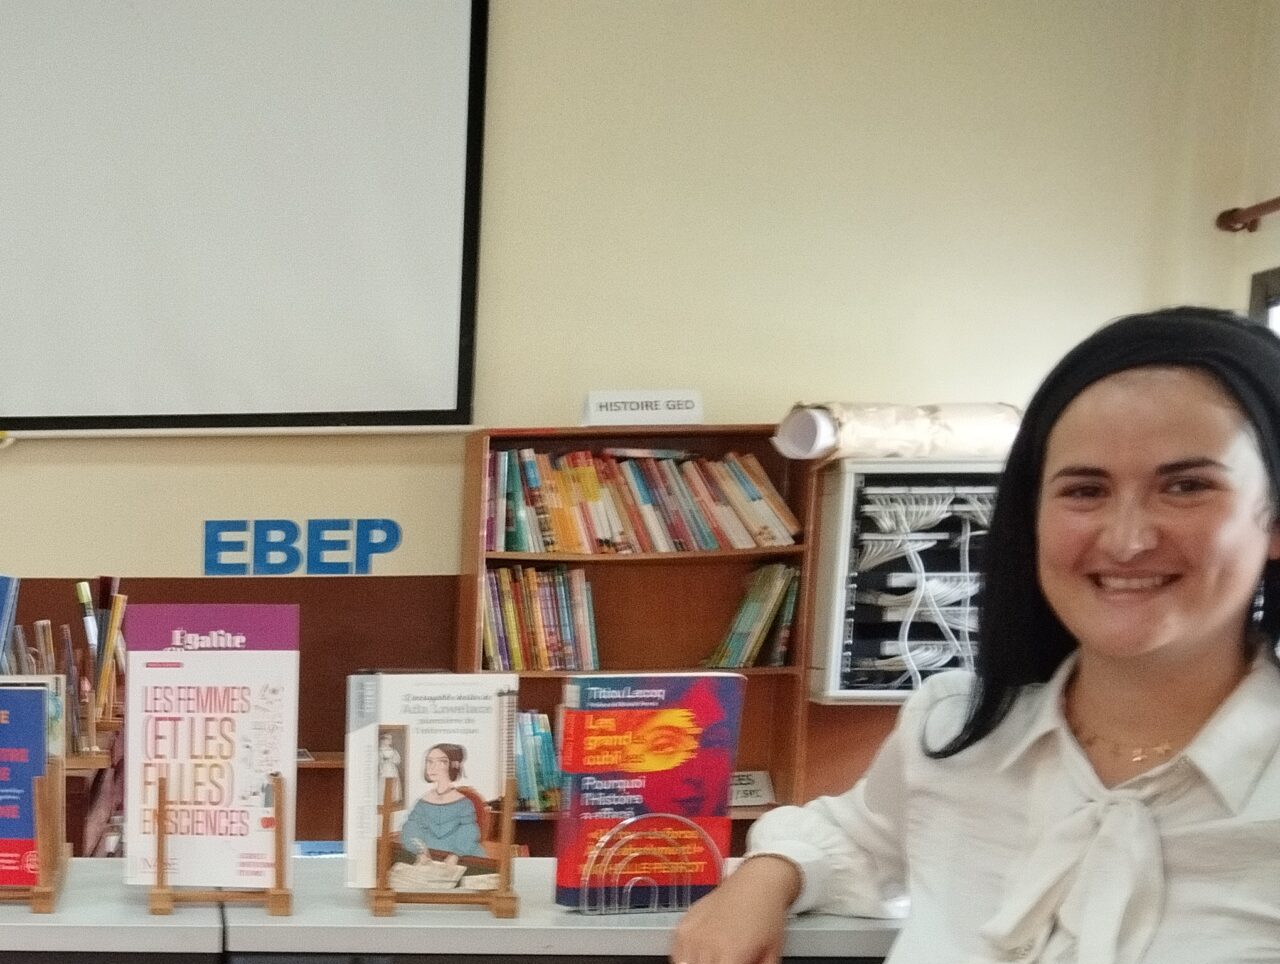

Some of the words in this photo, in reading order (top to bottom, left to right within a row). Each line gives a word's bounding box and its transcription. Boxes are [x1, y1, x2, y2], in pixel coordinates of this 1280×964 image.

[599, 400, 661, 412] HISTOIRE
[666, 399, 696, 411] GEO
[204, 518, 403, 576] EBEP
[144, 686, 173, 713] LES
[177, 686, 252, 713] FEMMES
[189, 717, 237, 760] LES
[165, 809, 250, 837] SCIENCES
